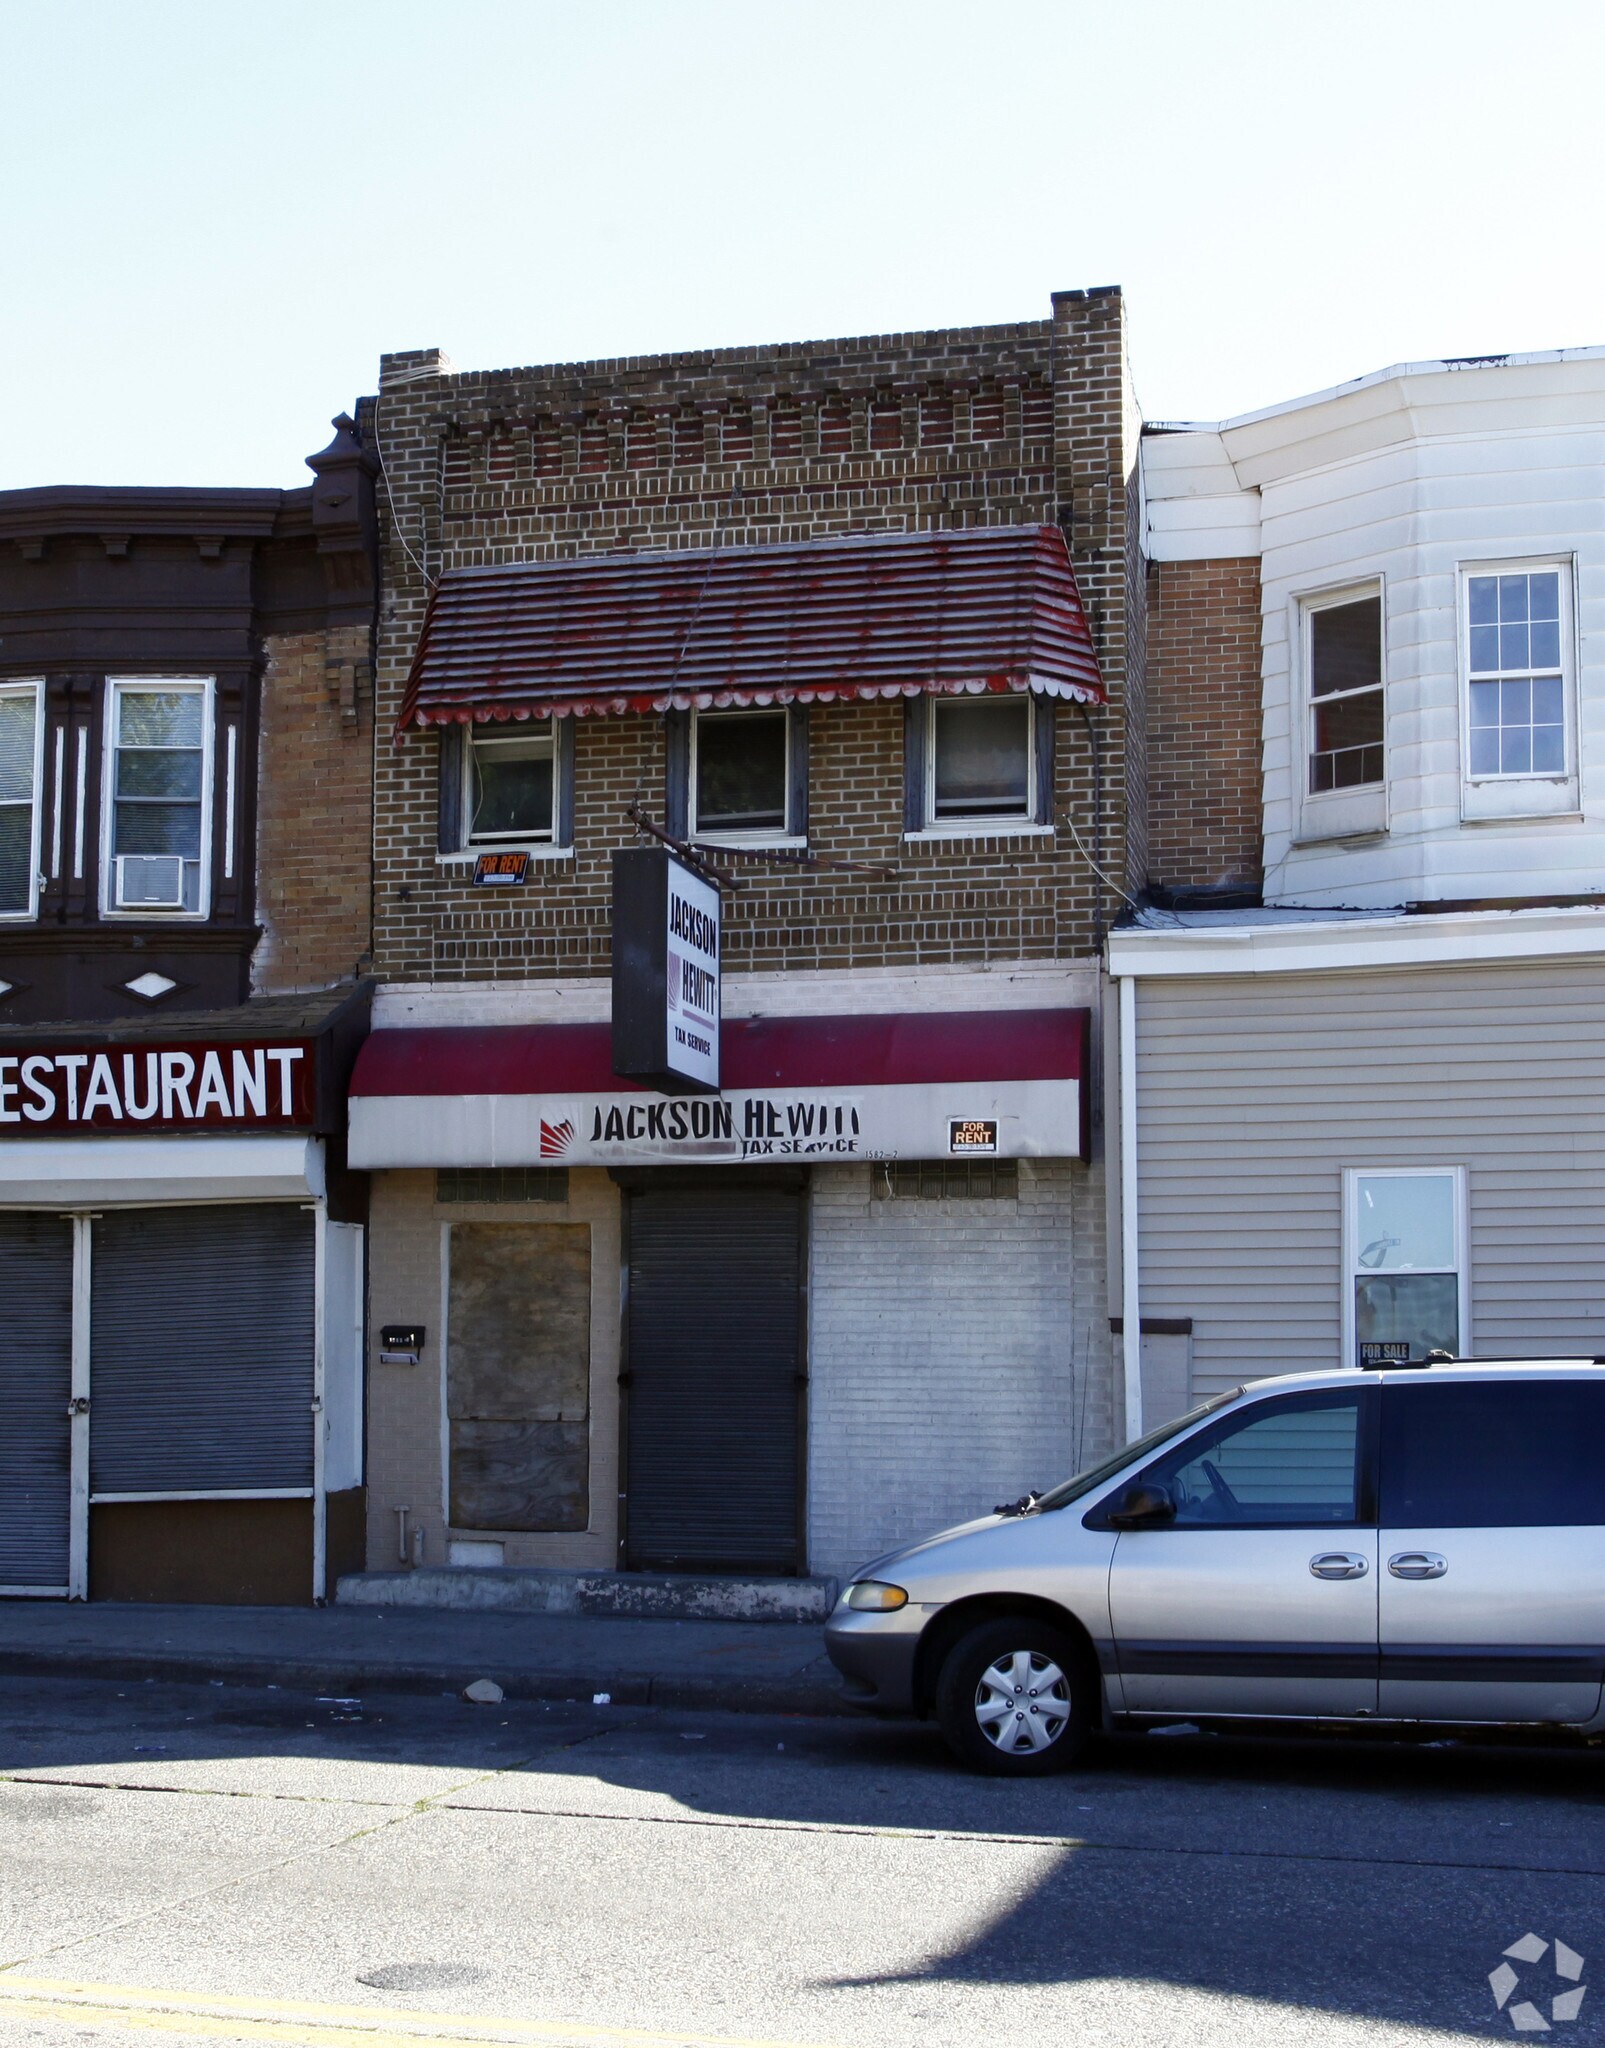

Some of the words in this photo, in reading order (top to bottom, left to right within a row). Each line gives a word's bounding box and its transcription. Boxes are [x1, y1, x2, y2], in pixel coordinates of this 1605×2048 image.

[478, 856, 498, 873] FOR
[499, 854, 527, 873] RENT
[670, 892, 716, 959] JACKSON
[682, 958, 716, 1015] HEWITT
[675, 1025, 687, 1045] TAX
[687, 1032, 711, 1057] SERVICE
[590, 1100, 732, 1141] JACKSON
[962, 1122, 985, 1132] FOR
[955, 1131, 992, 1144] RENT
[742, 1140, 774, 1160] TAX
[780, 1138, 859, 1154] SERVICE
[865, 1150, 898, 1159] 1582-2
[1362, 1344, 1381, 1358] FOR
[1384, 1344, 1408, 1358] SALE
